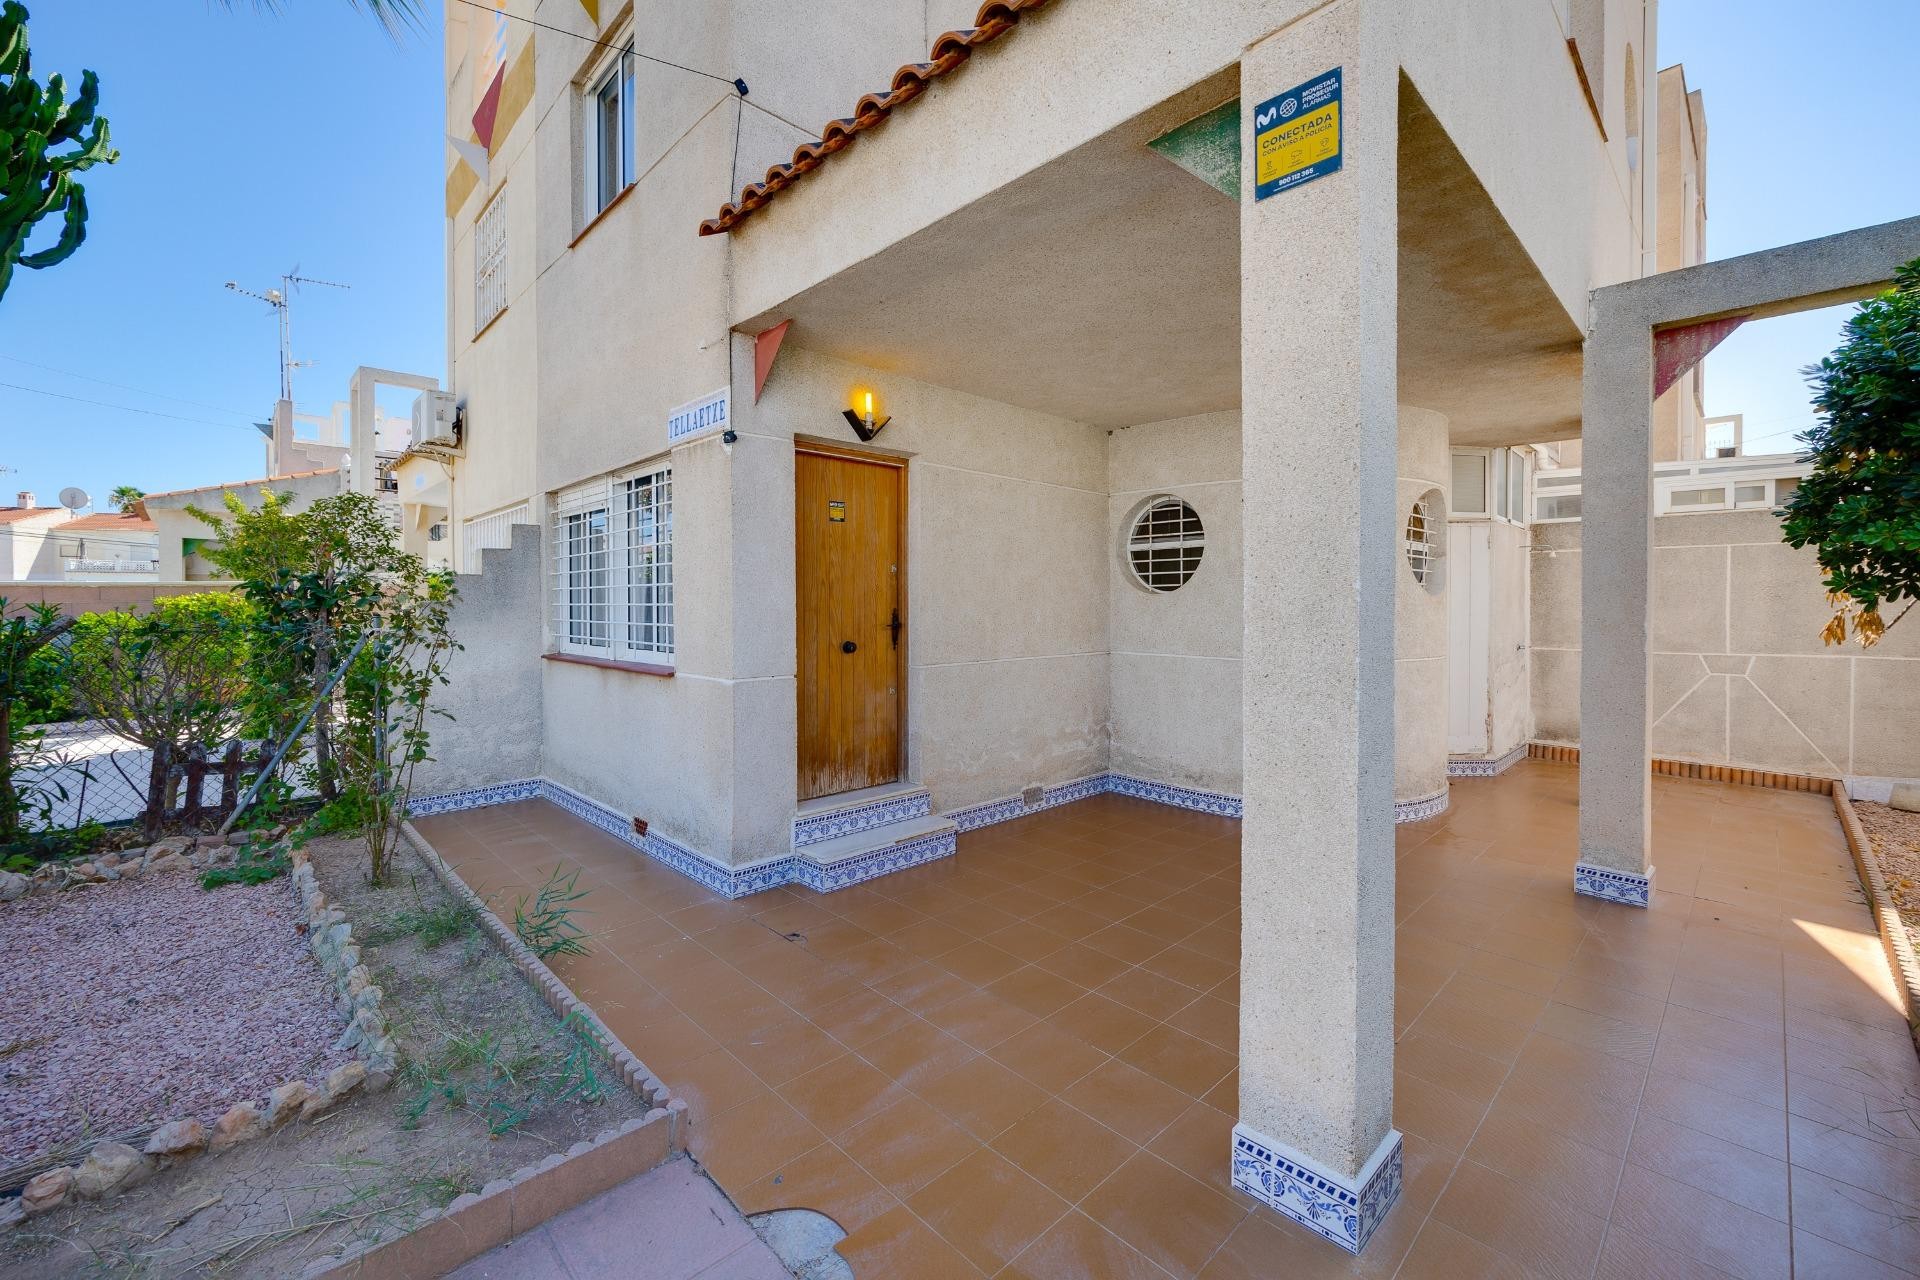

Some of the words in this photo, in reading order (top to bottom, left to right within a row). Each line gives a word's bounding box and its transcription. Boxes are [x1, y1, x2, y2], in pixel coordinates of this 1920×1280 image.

[1302, 77, 1336, 97] MOVISTAR
[1302, 83, 1338, 104] PROSEGUR
[1302, 93, 1331, 109] ALARMAS
[1262, 113, 1332, 149] CONECTADA
[1262, 144, 1277, 156] CON
[1278, 138, 1299, 151] AVISO
[1278, 177, 1291, 186] 900
[1291, 173, 1301, 182] 112
[669, 400, 726, 439] TELLAETXE
